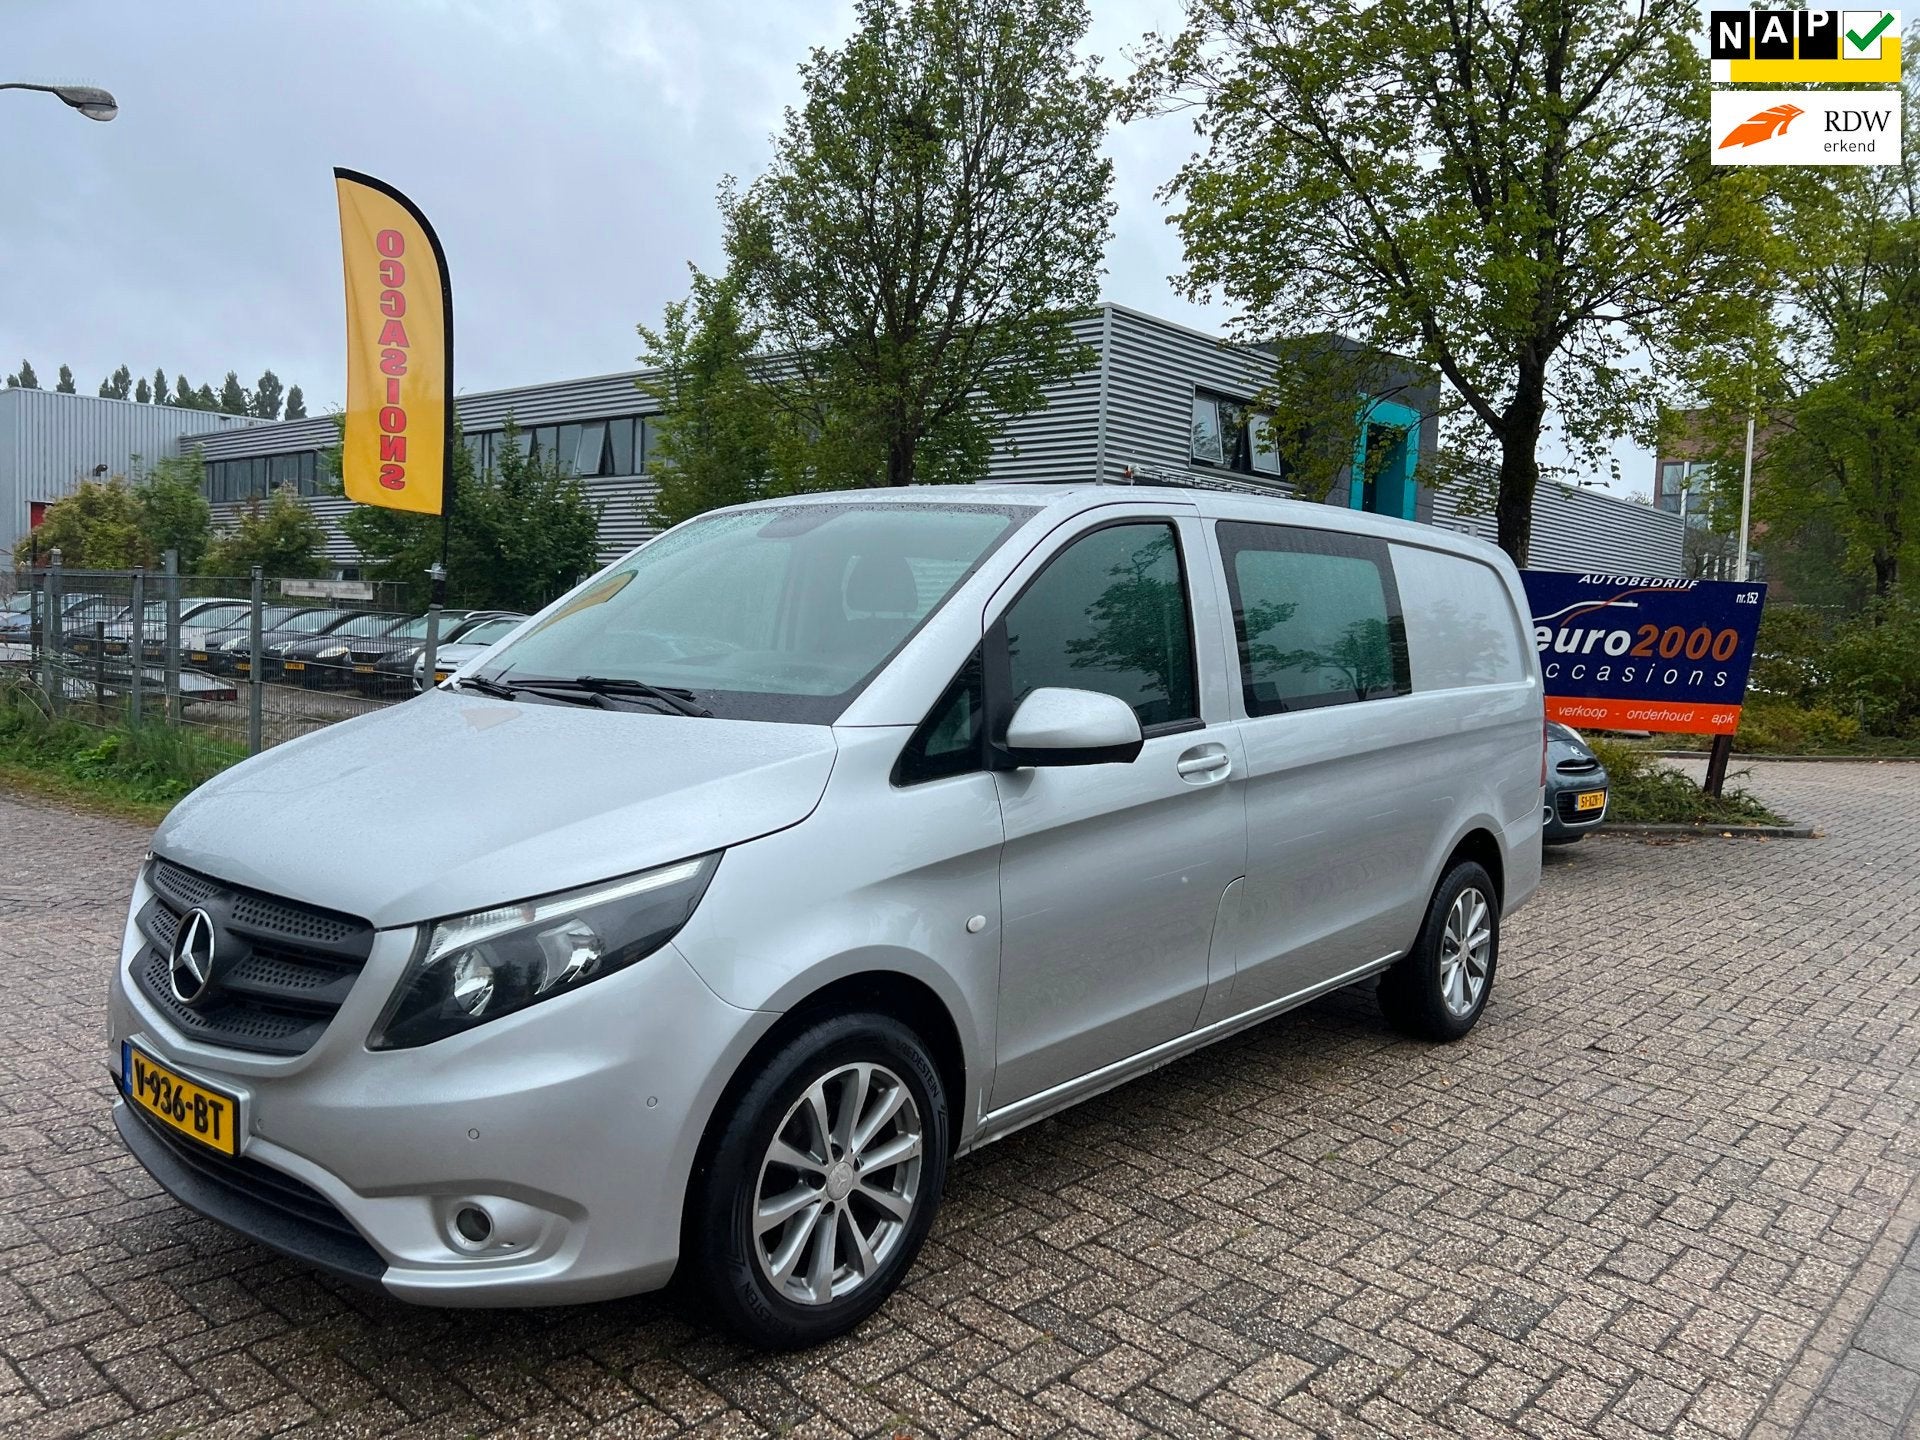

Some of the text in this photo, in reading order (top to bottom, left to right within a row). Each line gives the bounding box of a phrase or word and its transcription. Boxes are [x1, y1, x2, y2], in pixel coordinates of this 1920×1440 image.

[1578, 574, 1700, 590] AUTOBEDRIJF
[1736, 592, 1759, 605] nr.152
[1545, 663, 1728, 687] ccasions
[1558, 705, 1608, 718] verkoop
[1626, 708, 1694, 722] onderhoud
[1711, 713, 1735, 724] apk
[134, 1058, 224, 1140] V-936-BT
